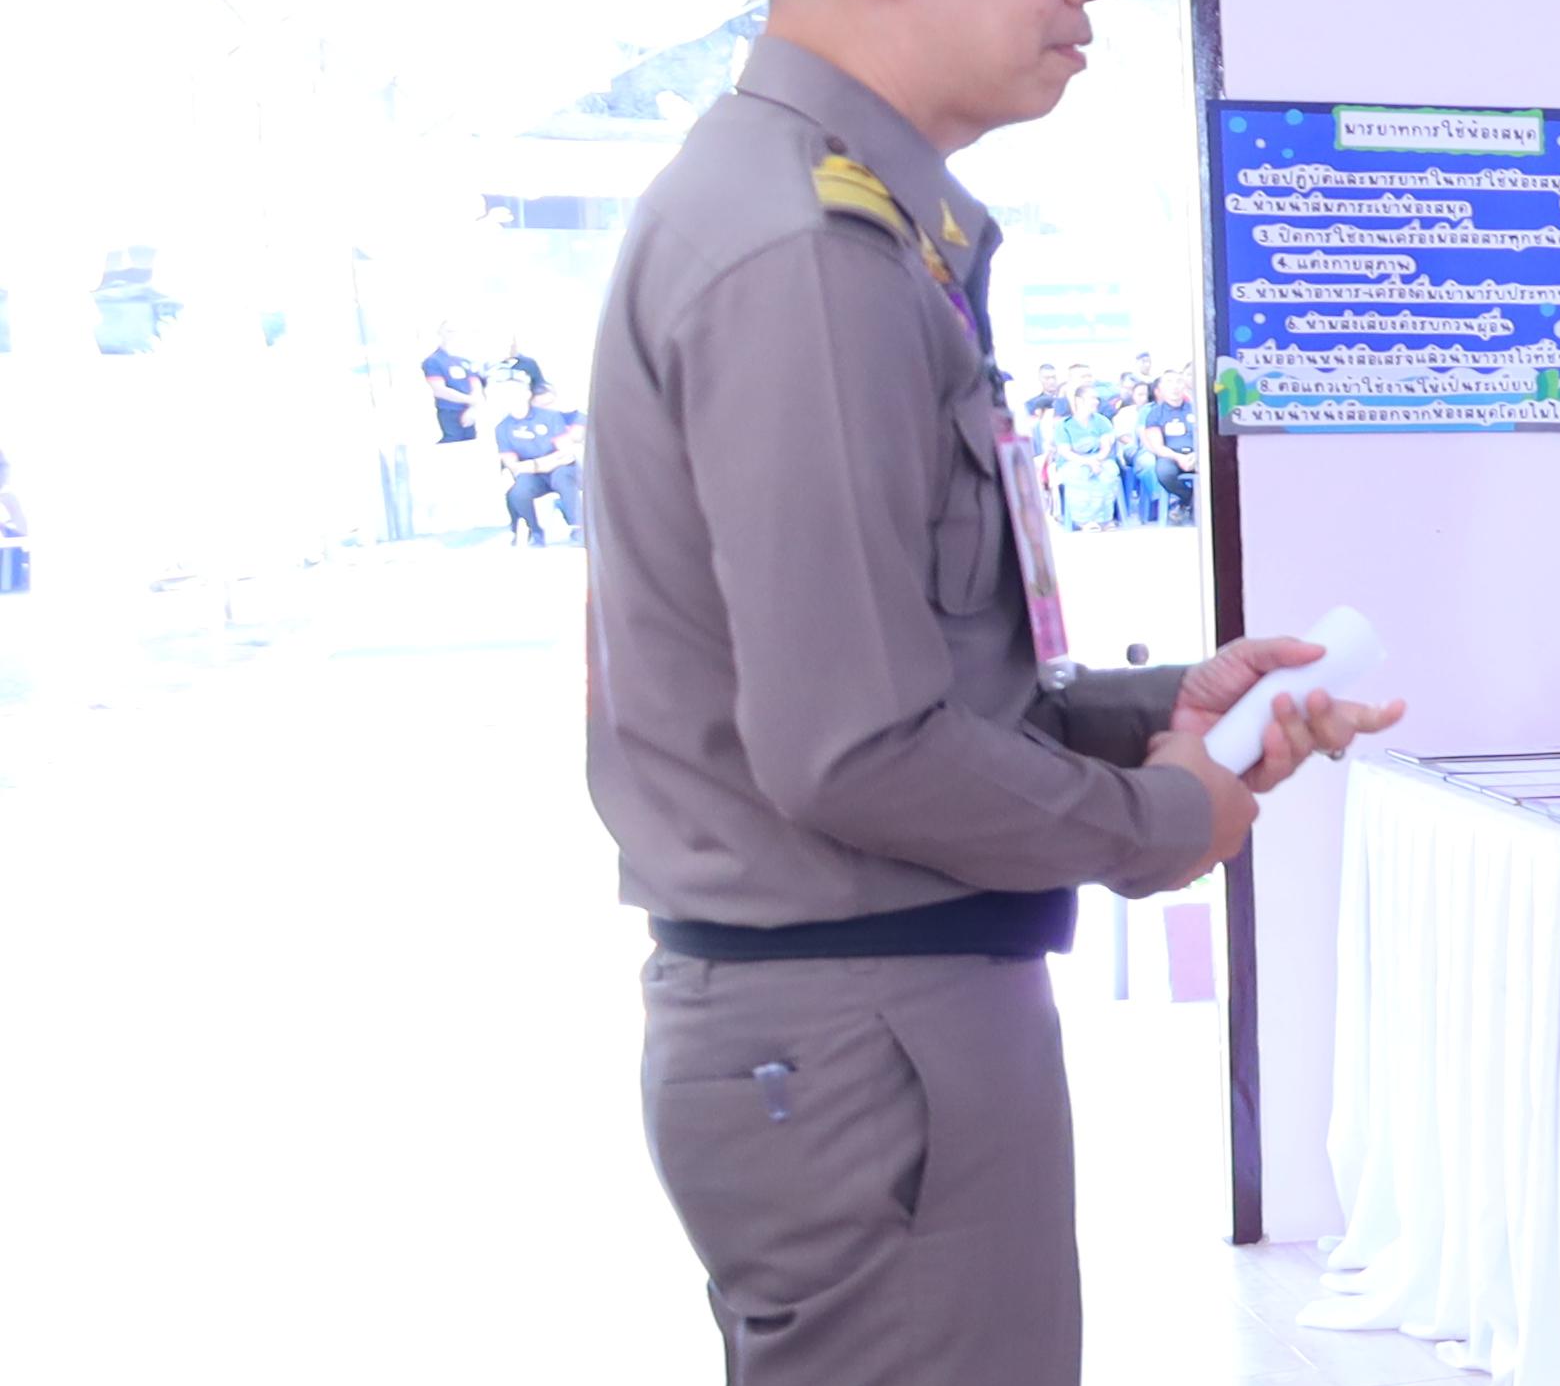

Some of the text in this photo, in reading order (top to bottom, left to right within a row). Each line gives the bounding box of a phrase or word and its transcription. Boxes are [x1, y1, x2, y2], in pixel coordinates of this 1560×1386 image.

[1345, 120, 1537, 146] มารยาทการใช้ห้องสมุด
